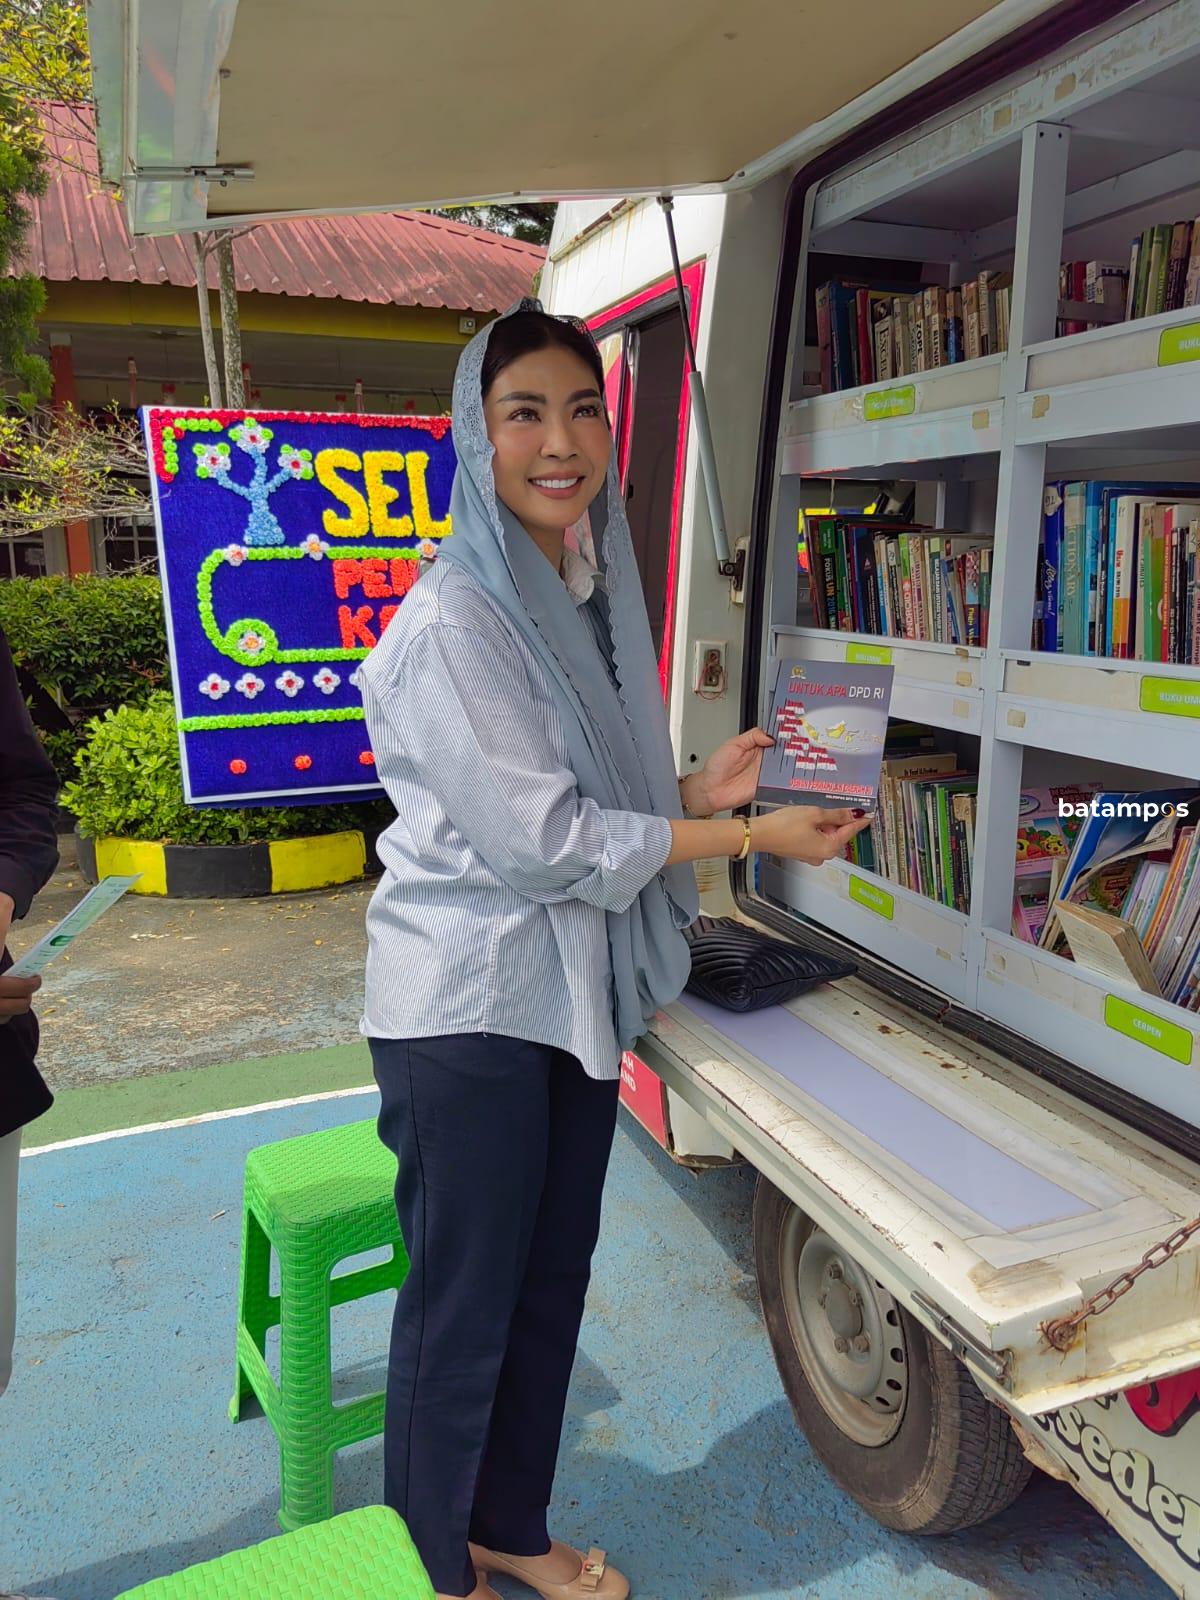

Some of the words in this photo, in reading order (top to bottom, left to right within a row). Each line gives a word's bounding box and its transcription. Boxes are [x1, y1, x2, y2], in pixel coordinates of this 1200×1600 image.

[878, 327, 890, 377] EXCEL
[1065, 525, 1078, 598] ICTIONARY
[903, 591, 914, 638] ANDROID
[788, 681, 825, 696] UNTUK
[826, 684, 847, 698] APA
[848, 685, 871, 699] DPD
[873, 687, 885, 700] RI
